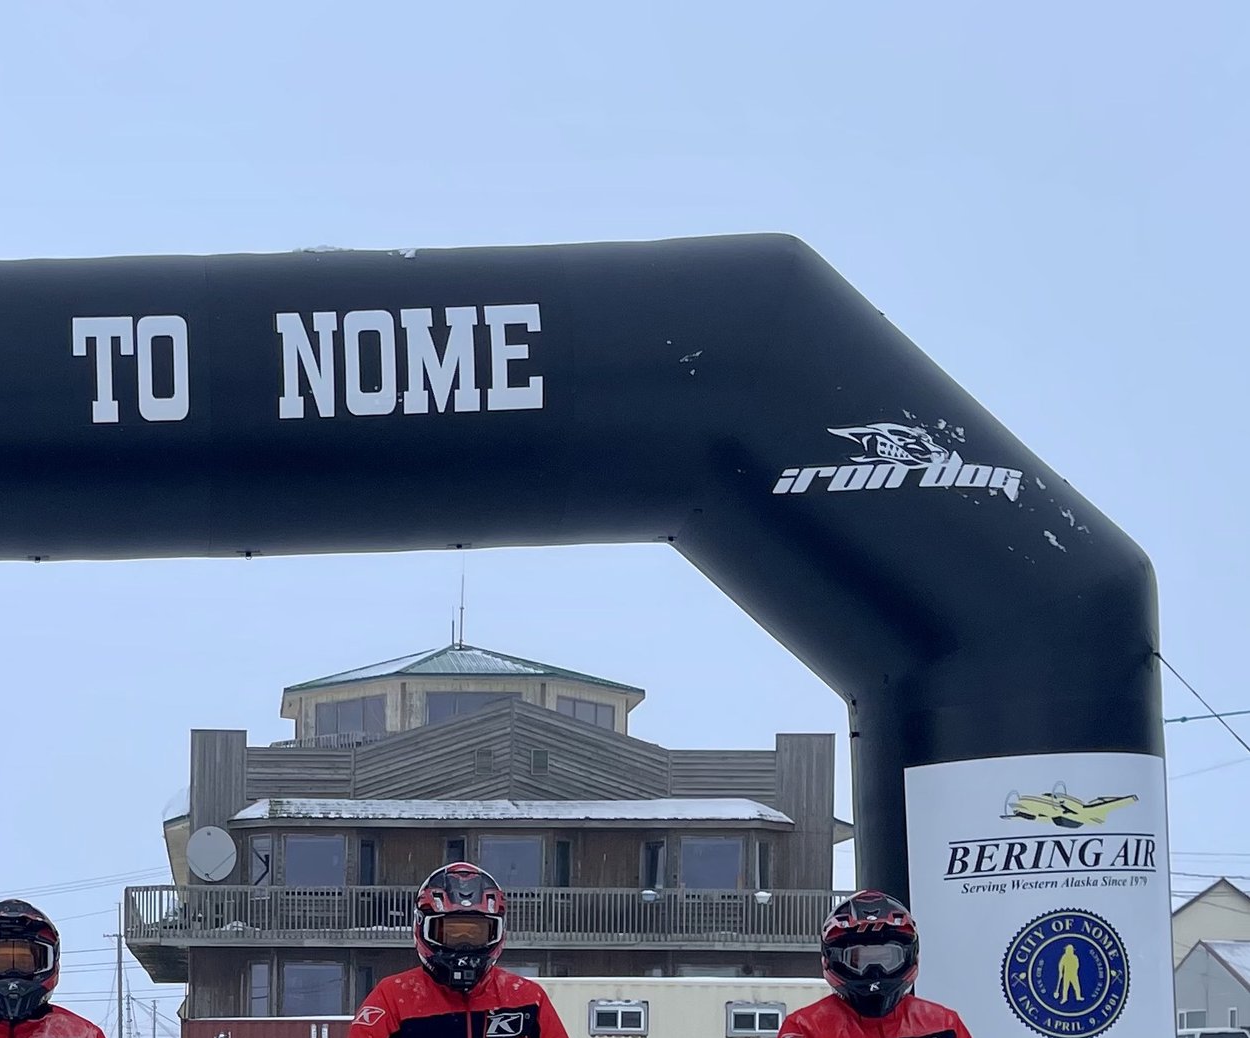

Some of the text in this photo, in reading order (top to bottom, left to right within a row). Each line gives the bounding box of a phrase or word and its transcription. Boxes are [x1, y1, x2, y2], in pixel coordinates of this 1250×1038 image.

[72, 315, 189, 423] TO
[276, 303, 544, 419] NOME
[944, 838, 1156, 876] BERING AIR
[962, 876, 1148, 894] Serving Western Alaska Since 1979
[1015, 918, 1119, 963] CITY OF NOME
[1018, 995, 1039, 1020] INC.
[1043, 1017, 1085, 1031] APRIL
[1101, 993, 1119, 1017] 1901
